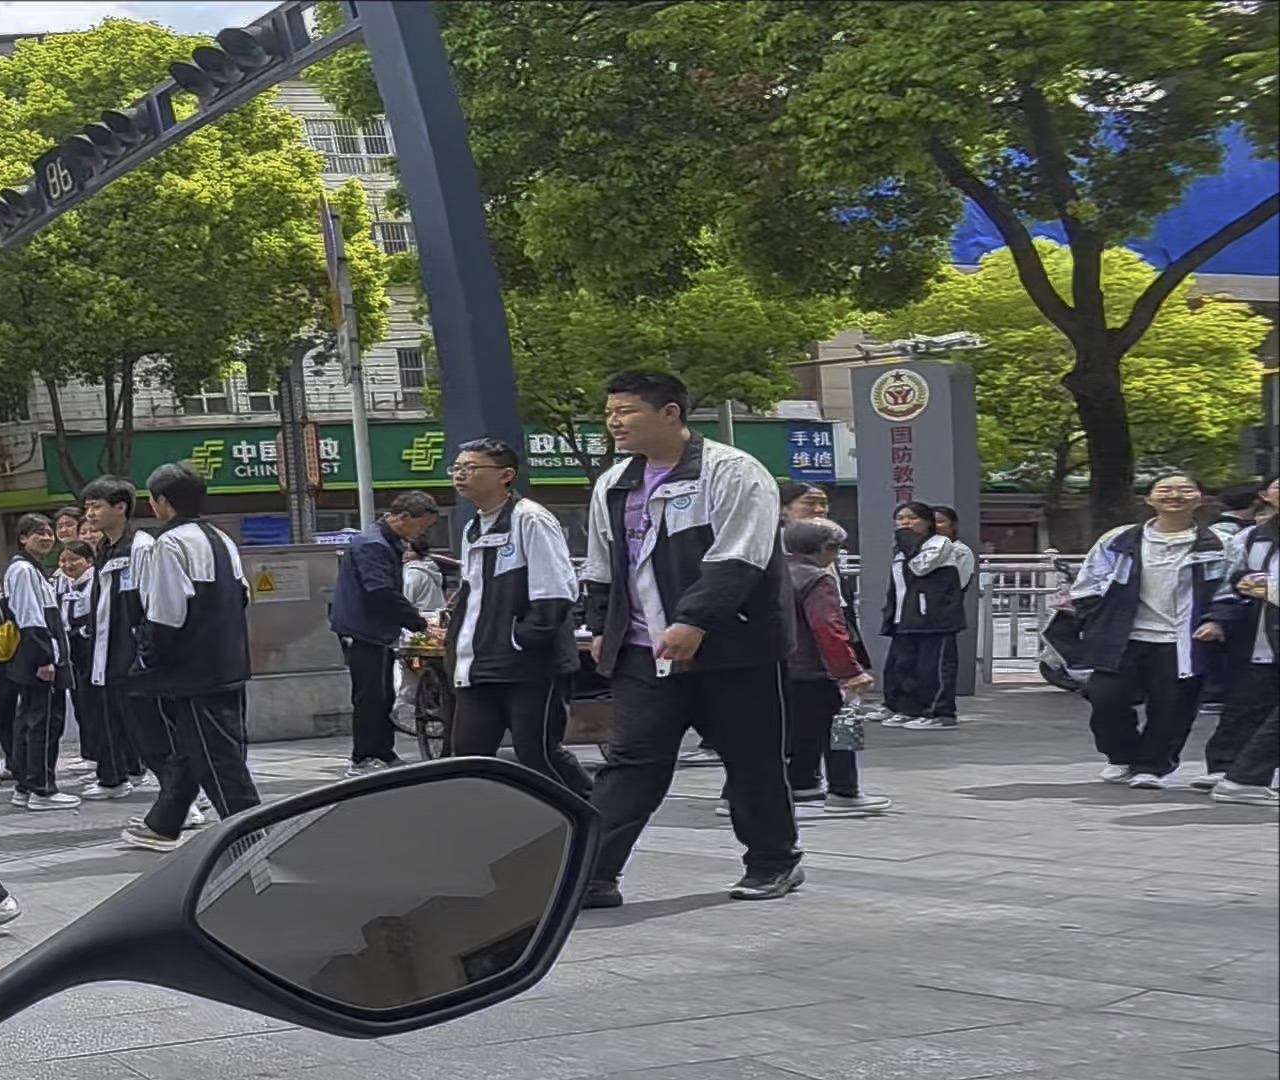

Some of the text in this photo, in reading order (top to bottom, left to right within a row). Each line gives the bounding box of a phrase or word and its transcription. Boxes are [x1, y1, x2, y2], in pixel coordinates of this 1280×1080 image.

[791, 430, 832, 446] 手机
[232, 438, 340, 464] 中国政
[792, 451, 833, 468] 维修
[234, 464, 281, 478] CHIN
[891, 426, 914, 504] 国防教育
